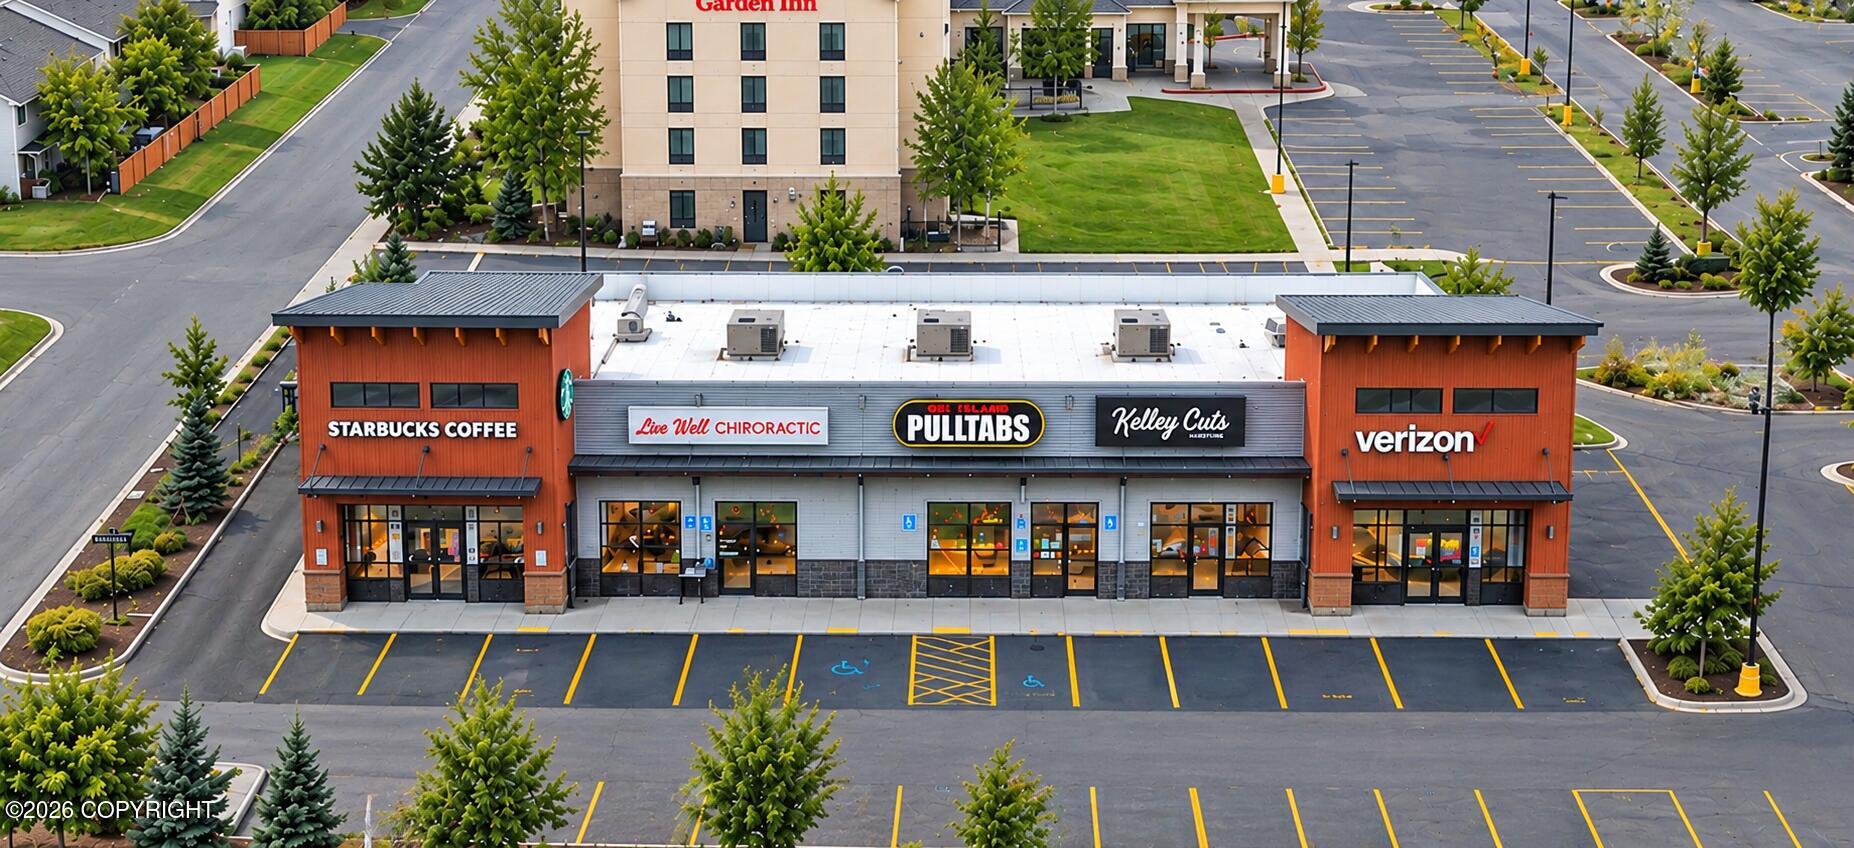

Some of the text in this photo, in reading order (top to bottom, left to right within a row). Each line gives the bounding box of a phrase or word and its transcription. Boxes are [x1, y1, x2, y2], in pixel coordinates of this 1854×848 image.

[696, 0, 818, 11] Garden Inn
[328, 421, 517, 438] STARBUCKS COFFEE
[635, 417, 821, 435] Live Well CHIRORACTIC
[907, 414, 1030, 442] PULLTABS
[1112, 407, 1230, 441] Kelley Cuts
[1355, 424, 1474, 452] verizon
